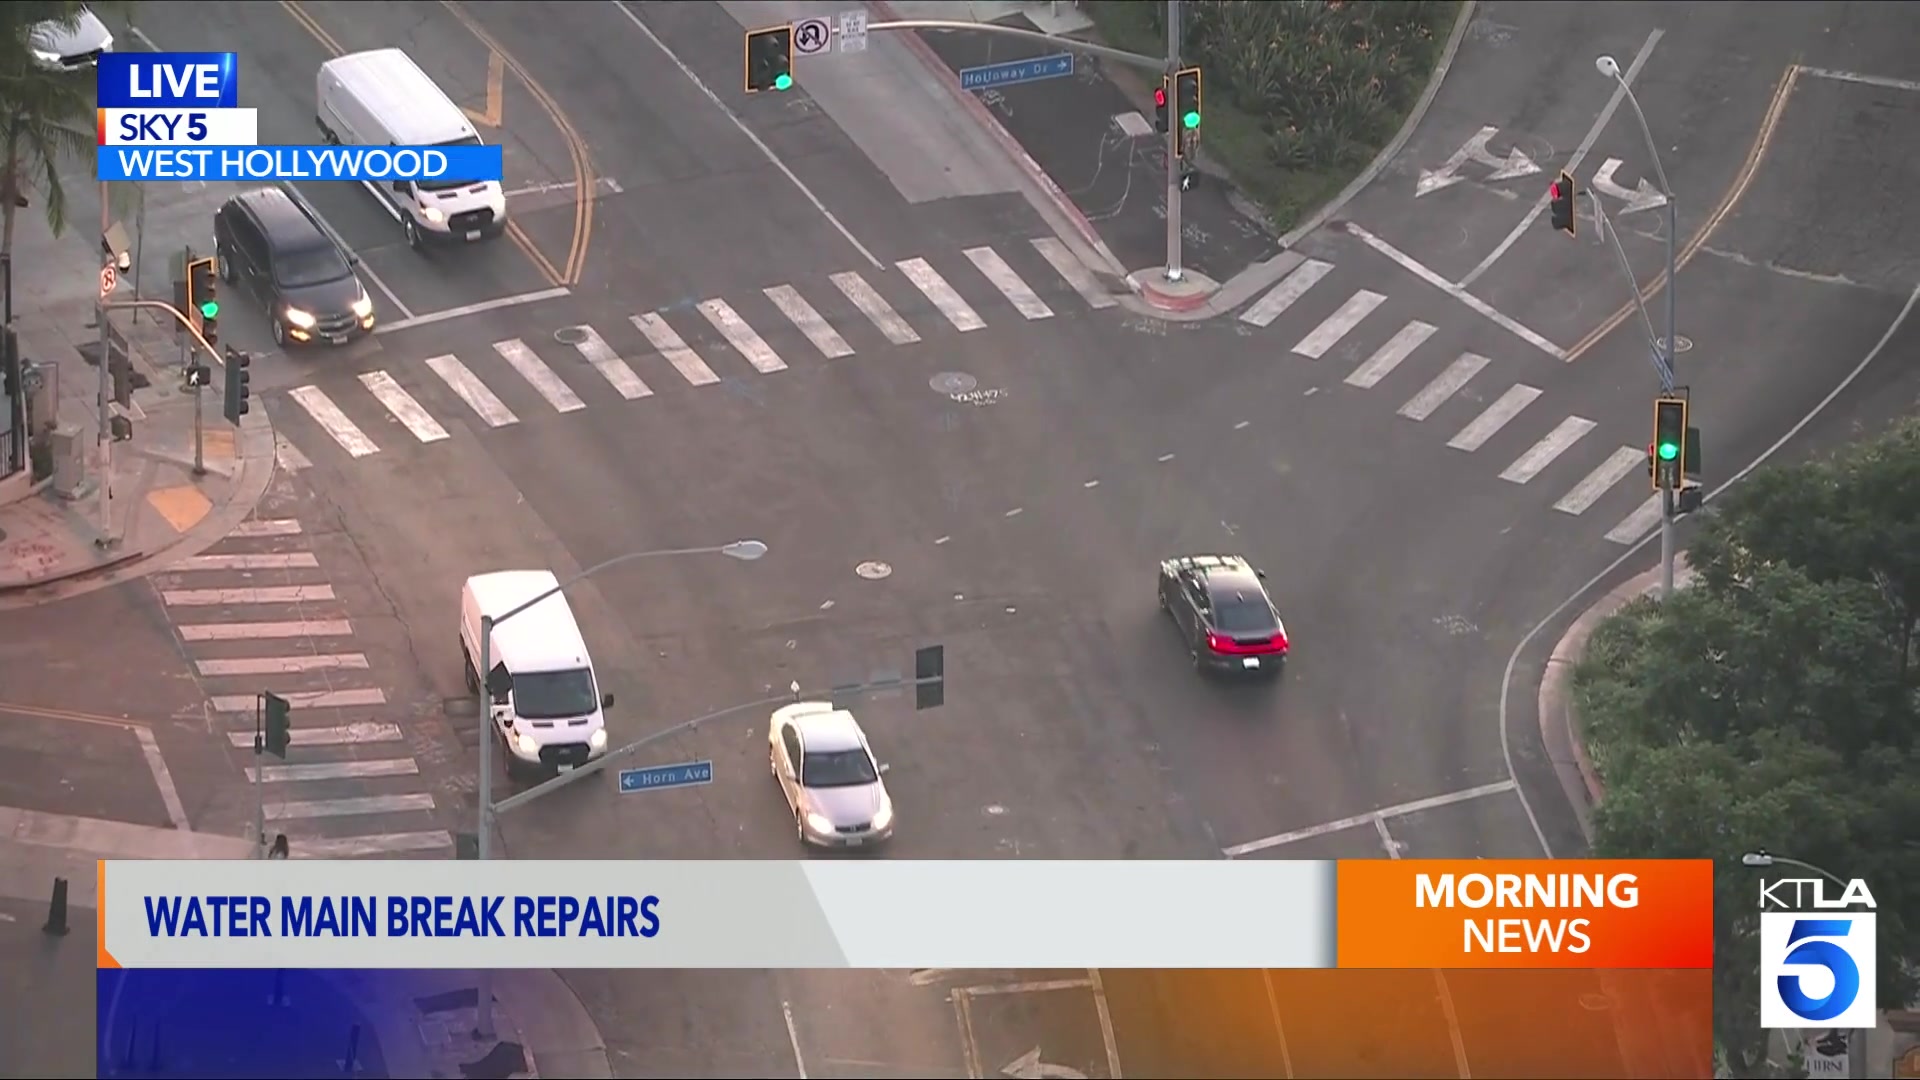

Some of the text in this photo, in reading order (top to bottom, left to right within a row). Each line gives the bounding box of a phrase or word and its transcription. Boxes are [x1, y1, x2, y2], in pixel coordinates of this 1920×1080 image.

[965, 64, 1048, 85] Holloway Dr
[642, 768, 709, 785] Horn Ave
